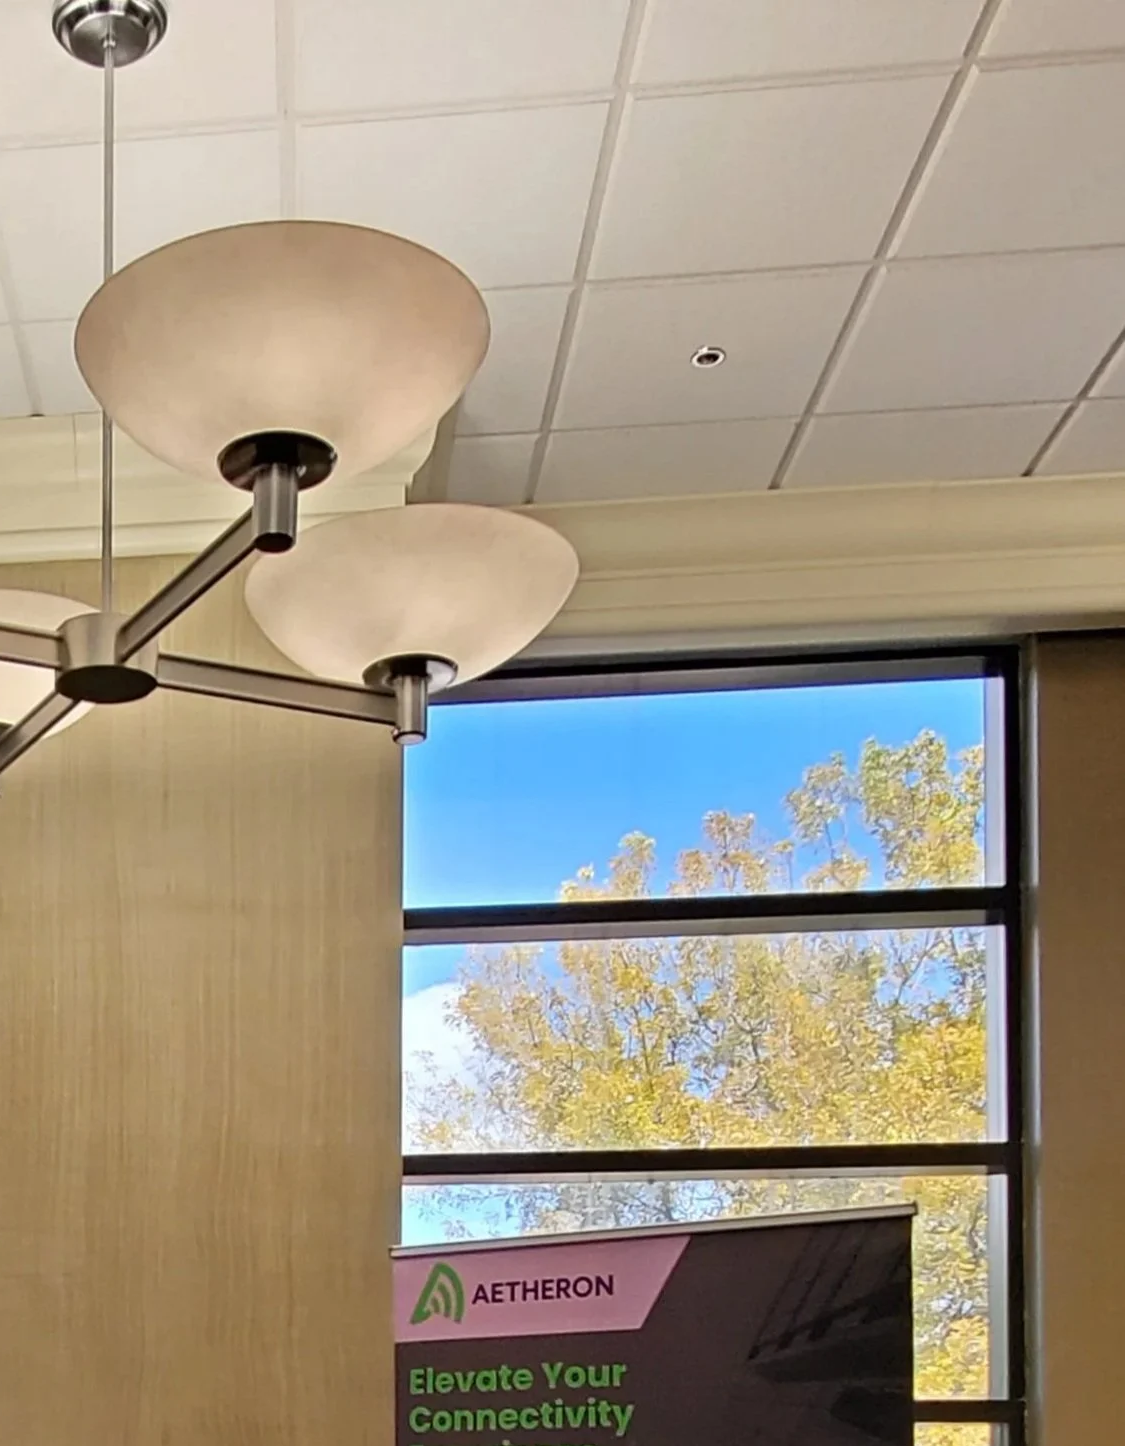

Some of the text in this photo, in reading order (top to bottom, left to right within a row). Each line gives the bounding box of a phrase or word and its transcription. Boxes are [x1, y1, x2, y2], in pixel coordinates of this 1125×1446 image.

[472, 1275, 614, 1304] AETHERON
[410, 1362, 627, 1395] Elevate Your
[410, 1397, 634, 1436] Connectivity
